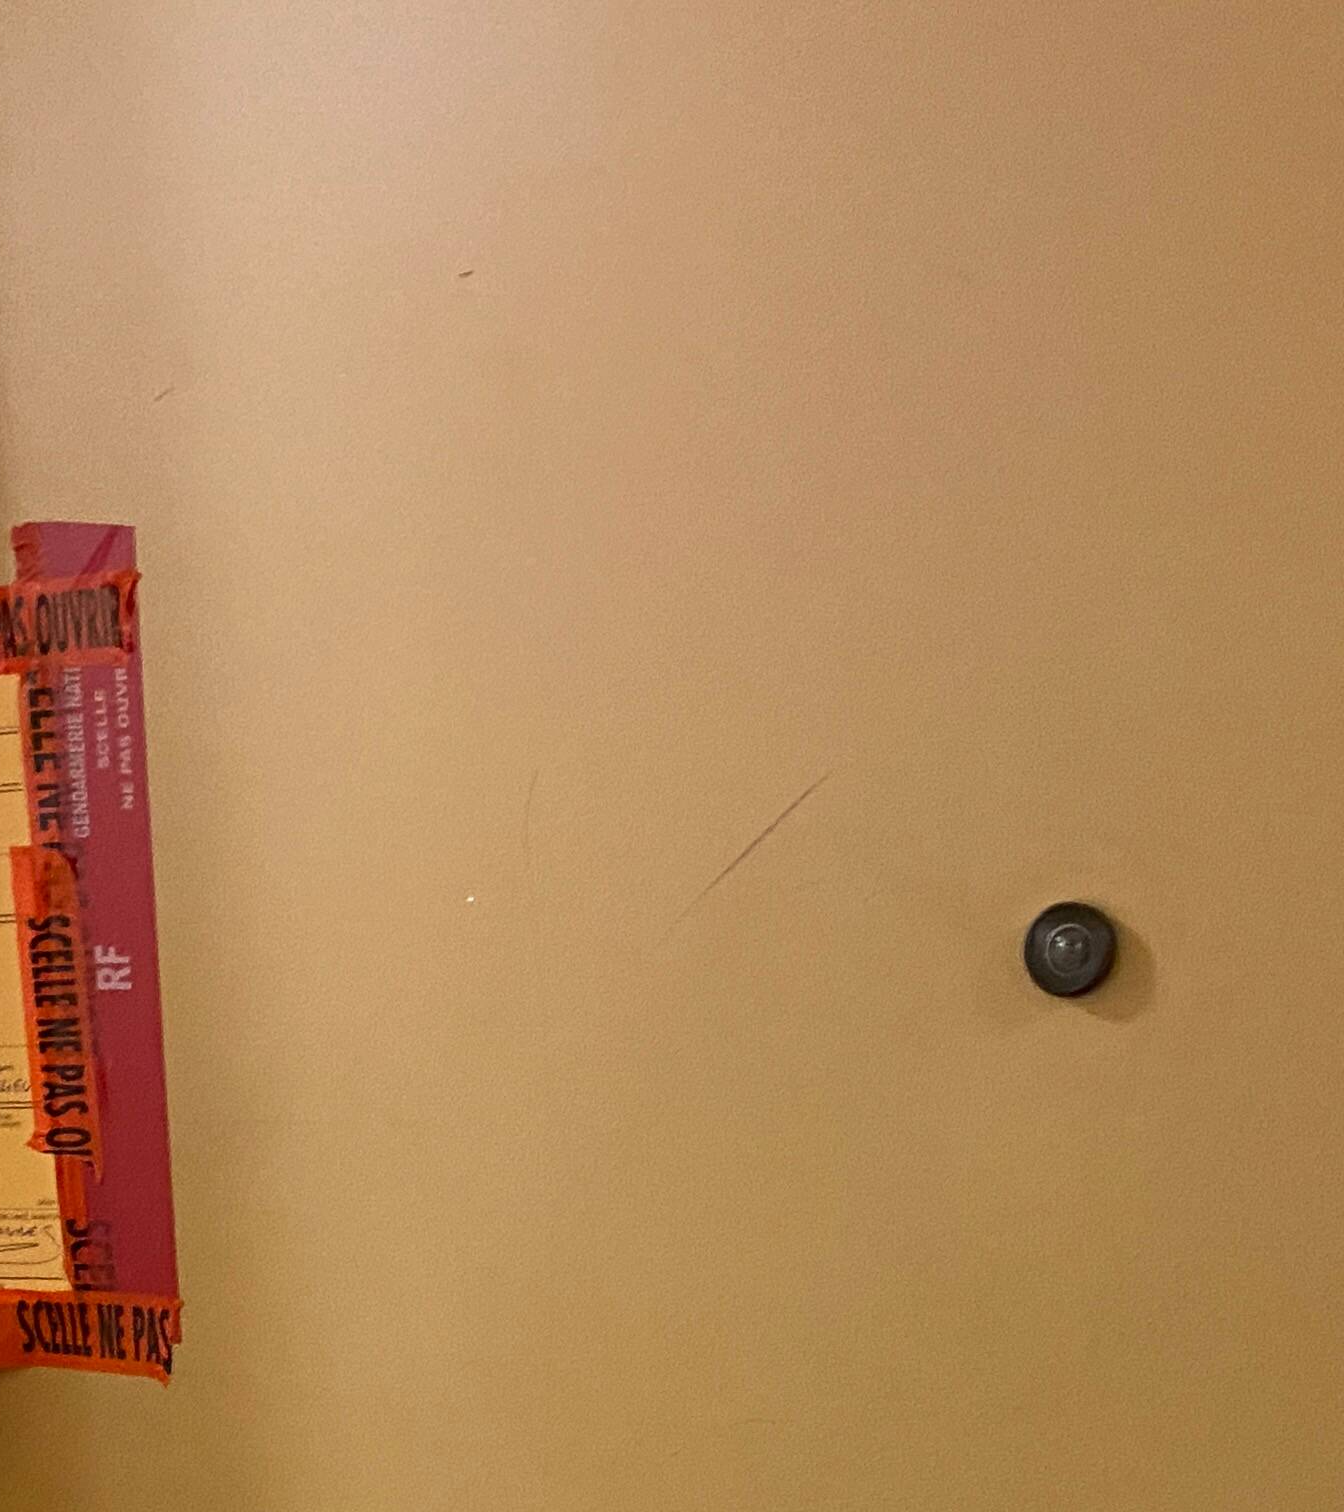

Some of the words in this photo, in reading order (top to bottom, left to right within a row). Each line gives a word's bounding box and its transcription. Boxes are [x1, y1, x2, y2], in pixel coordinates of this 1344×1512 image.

[94, 689, 110, 769] SCELLE
[118, 735, 134, 775] PAS
[66, 713, 90, 838] GENDARMERIE
[120, 782, 134, 811] NE
[27, 914, 79, 1008] SCELLE
[93, 944, 133, 990] RF
[35, 1017, 82, 1054] NE
[40, 1064, 90, 1118] PAS
[17, 1300, 92, 1357] SCELLE
[97, 1303, 126, 1360] NE
[132, 1305, 172, 1375] PAS
